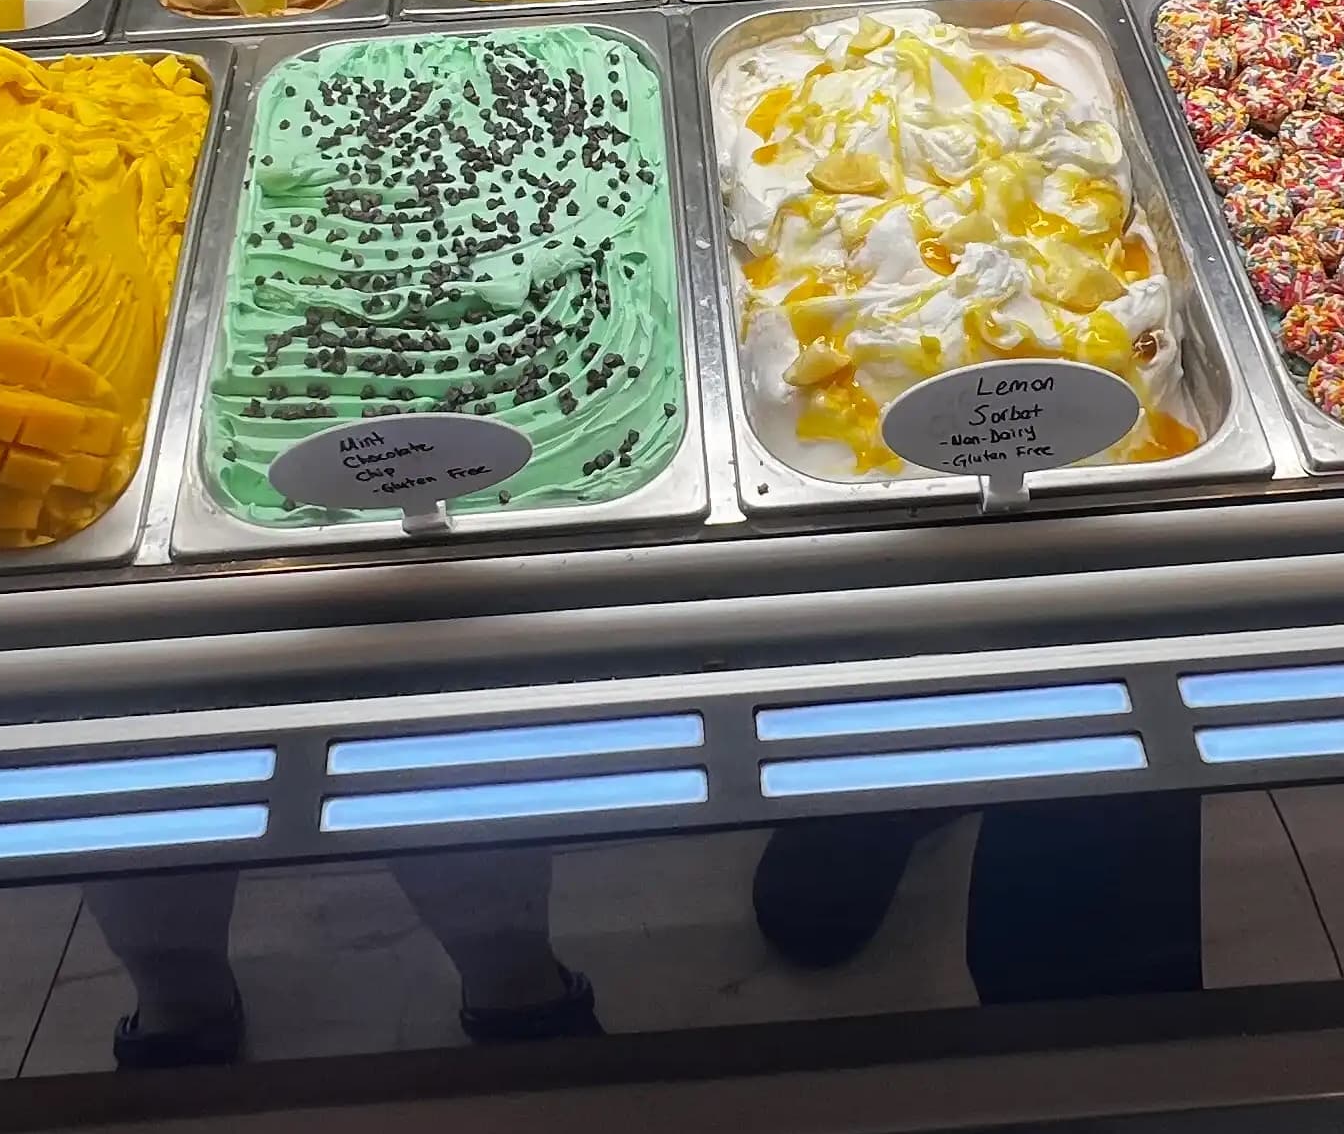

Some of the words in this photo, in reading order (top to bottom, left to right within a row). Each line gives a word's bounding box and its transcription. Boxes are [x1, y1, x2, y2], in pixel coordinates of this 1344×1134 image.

[977, 377, 1054, 396] Lemon
[340, 432, 385, 452] Mint
[343, 442, 435, 469] Chocolate
[1016, 446, 1055, 457] Free
[356, 467, 396, 482] Chip
[447, 465, 493, 479] Free
